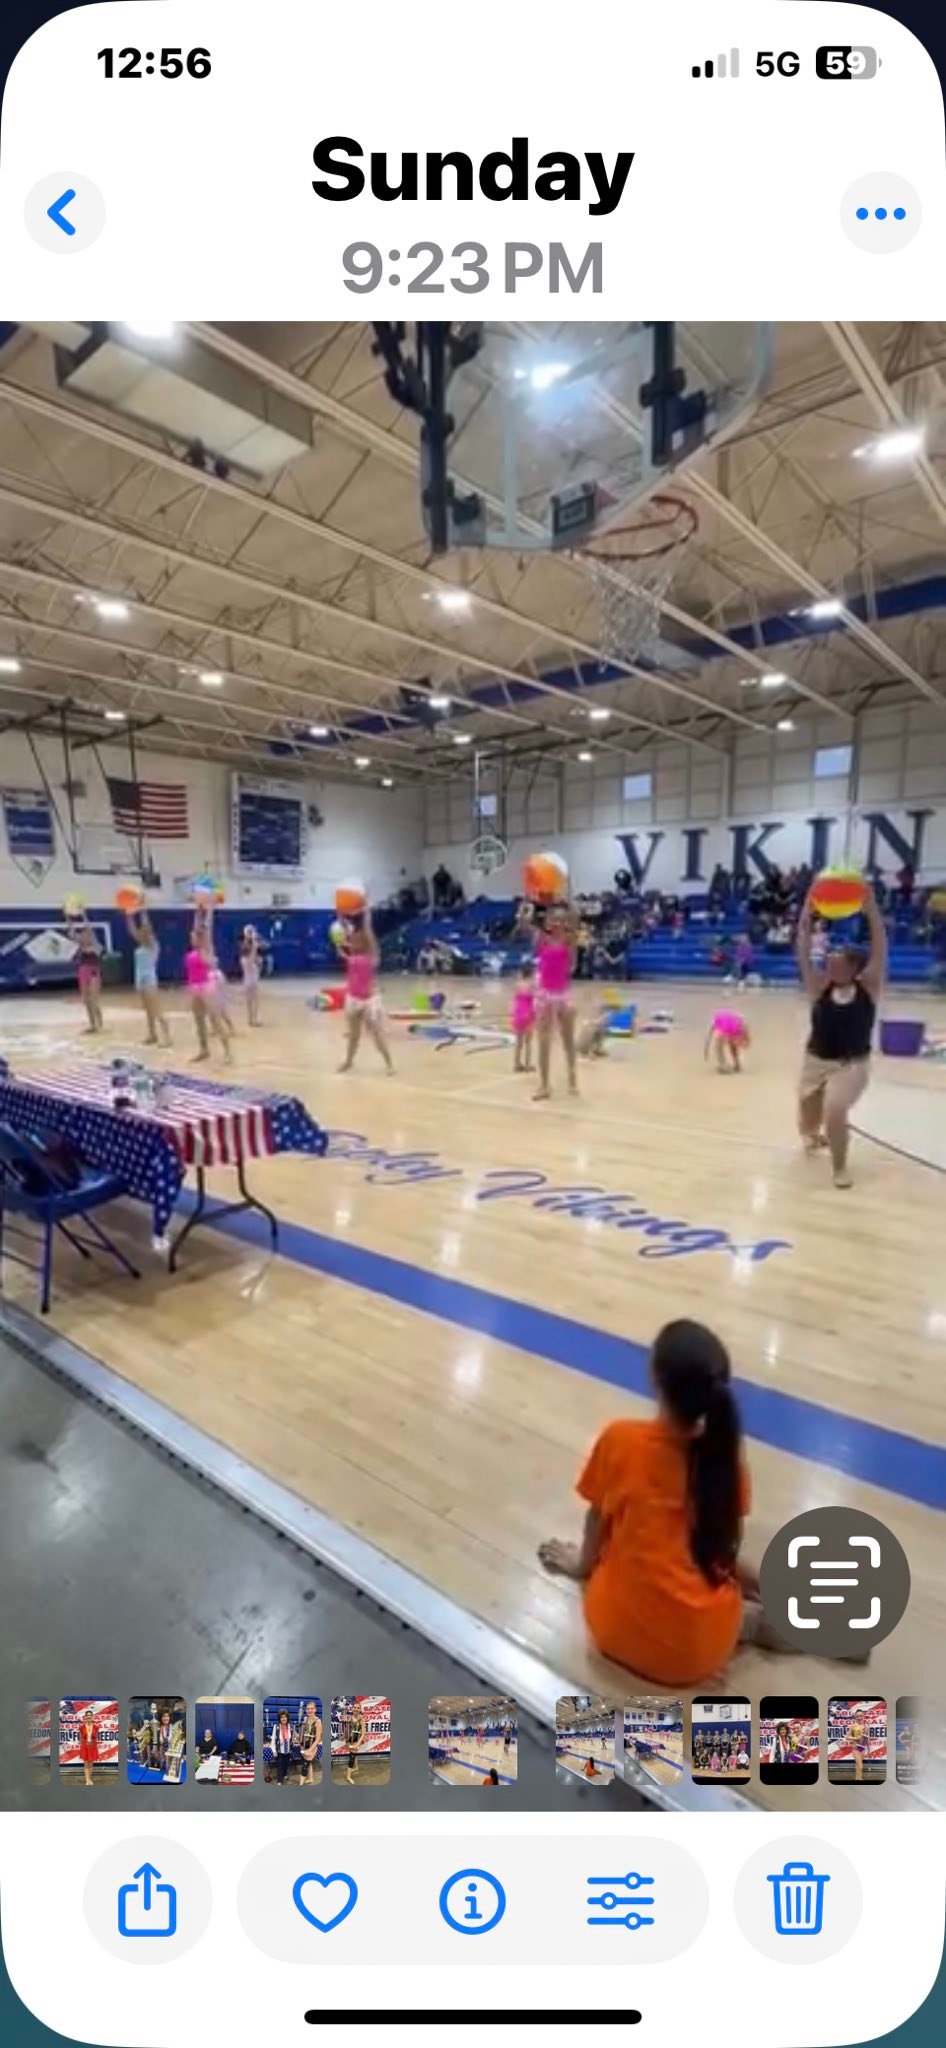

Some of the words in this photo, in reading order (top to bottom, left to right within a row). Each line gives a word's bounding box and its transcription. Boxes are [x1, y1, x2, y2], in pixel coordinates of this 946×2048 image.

[97, 47, 212, 79] 12:56
[756, 50, 800, 78] 5G
[825, 50, 867, 76] 59
[311, 135, 636, 216] Sunday
[342, 240, 491, 296] 9:23
[504, 241, 604, 295] PM
[614, 808, 936, 888] VIKIN
[476, 1170, 794, 1262] Vikings
